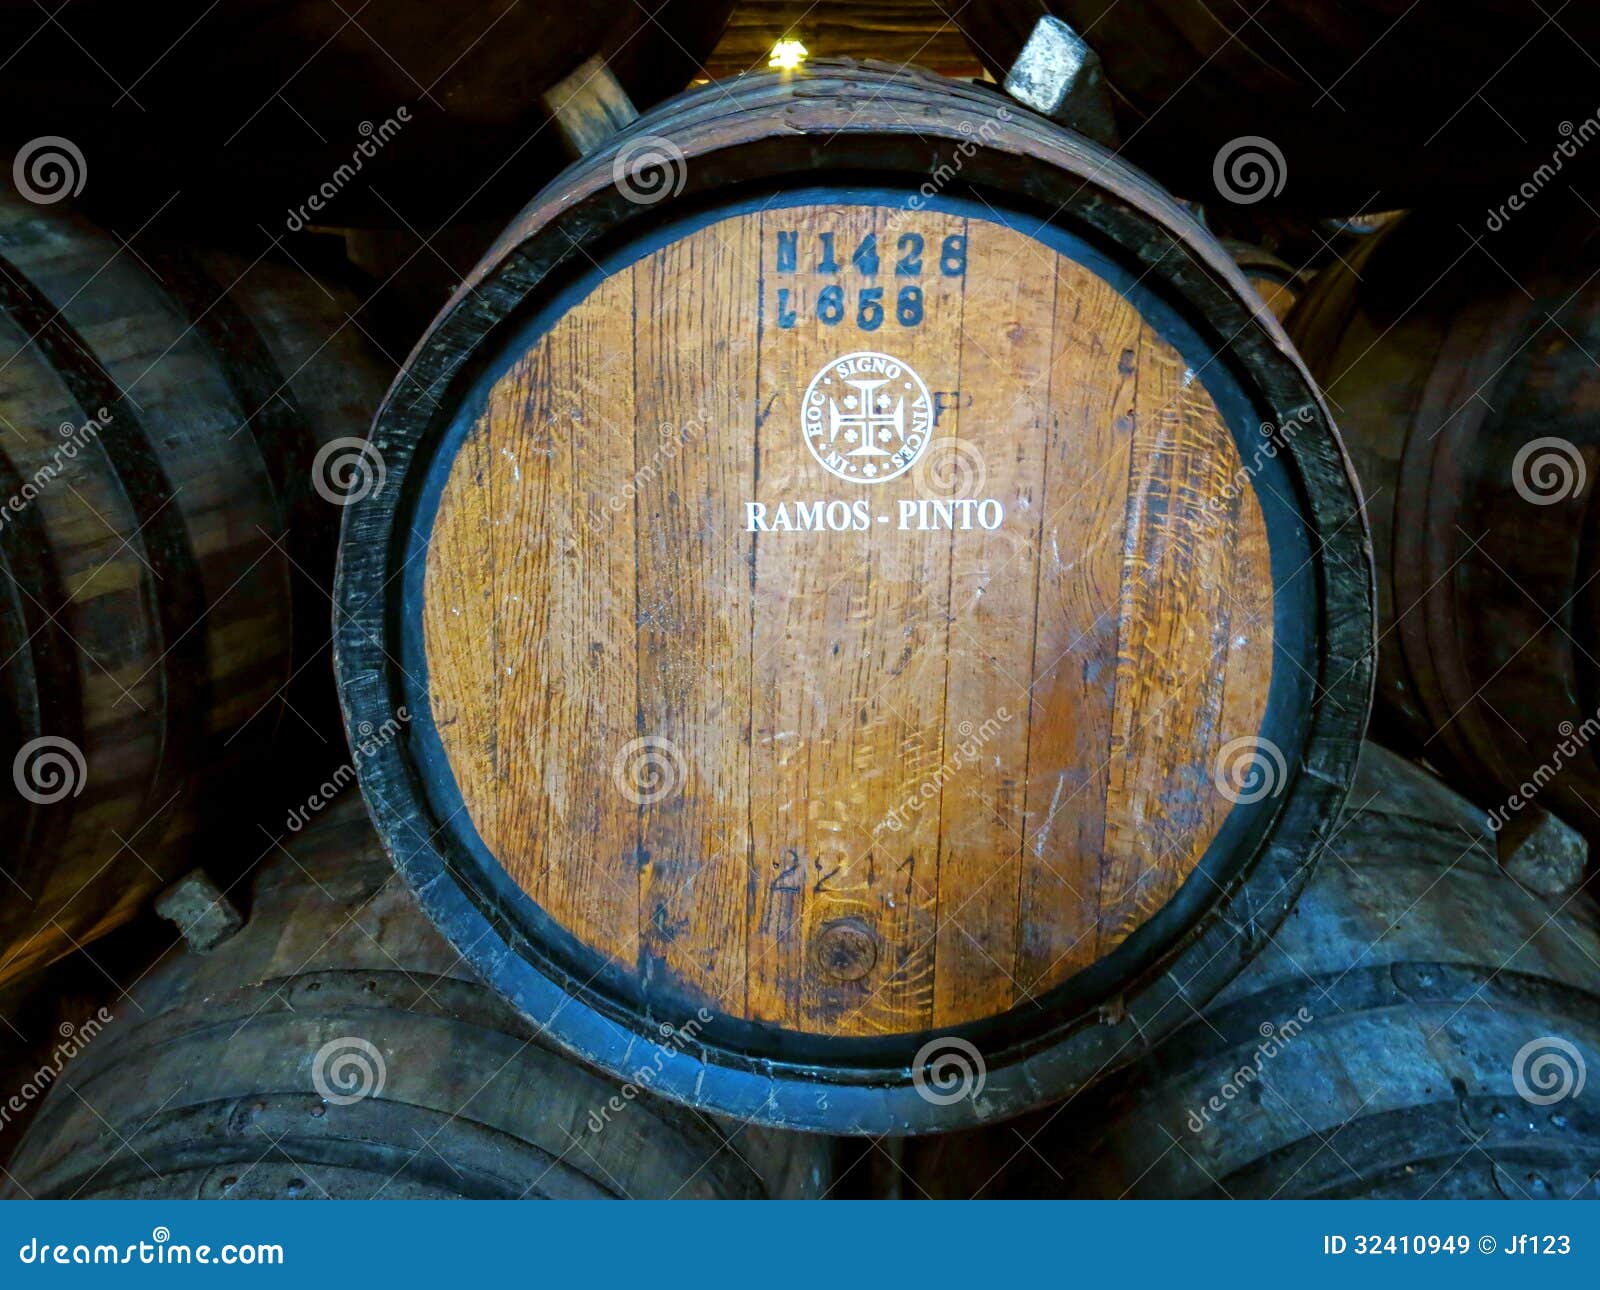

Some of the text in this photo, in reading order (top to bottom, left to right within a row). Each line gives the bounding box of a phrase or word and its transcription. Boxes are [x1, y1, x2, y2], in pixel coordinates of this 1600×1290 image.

[806, 357, 928, 474] IN HOC SIGNO VINCES
[744, 500, 870, 532] RAMOS
[896, 499, 1005, 531] PINTO
